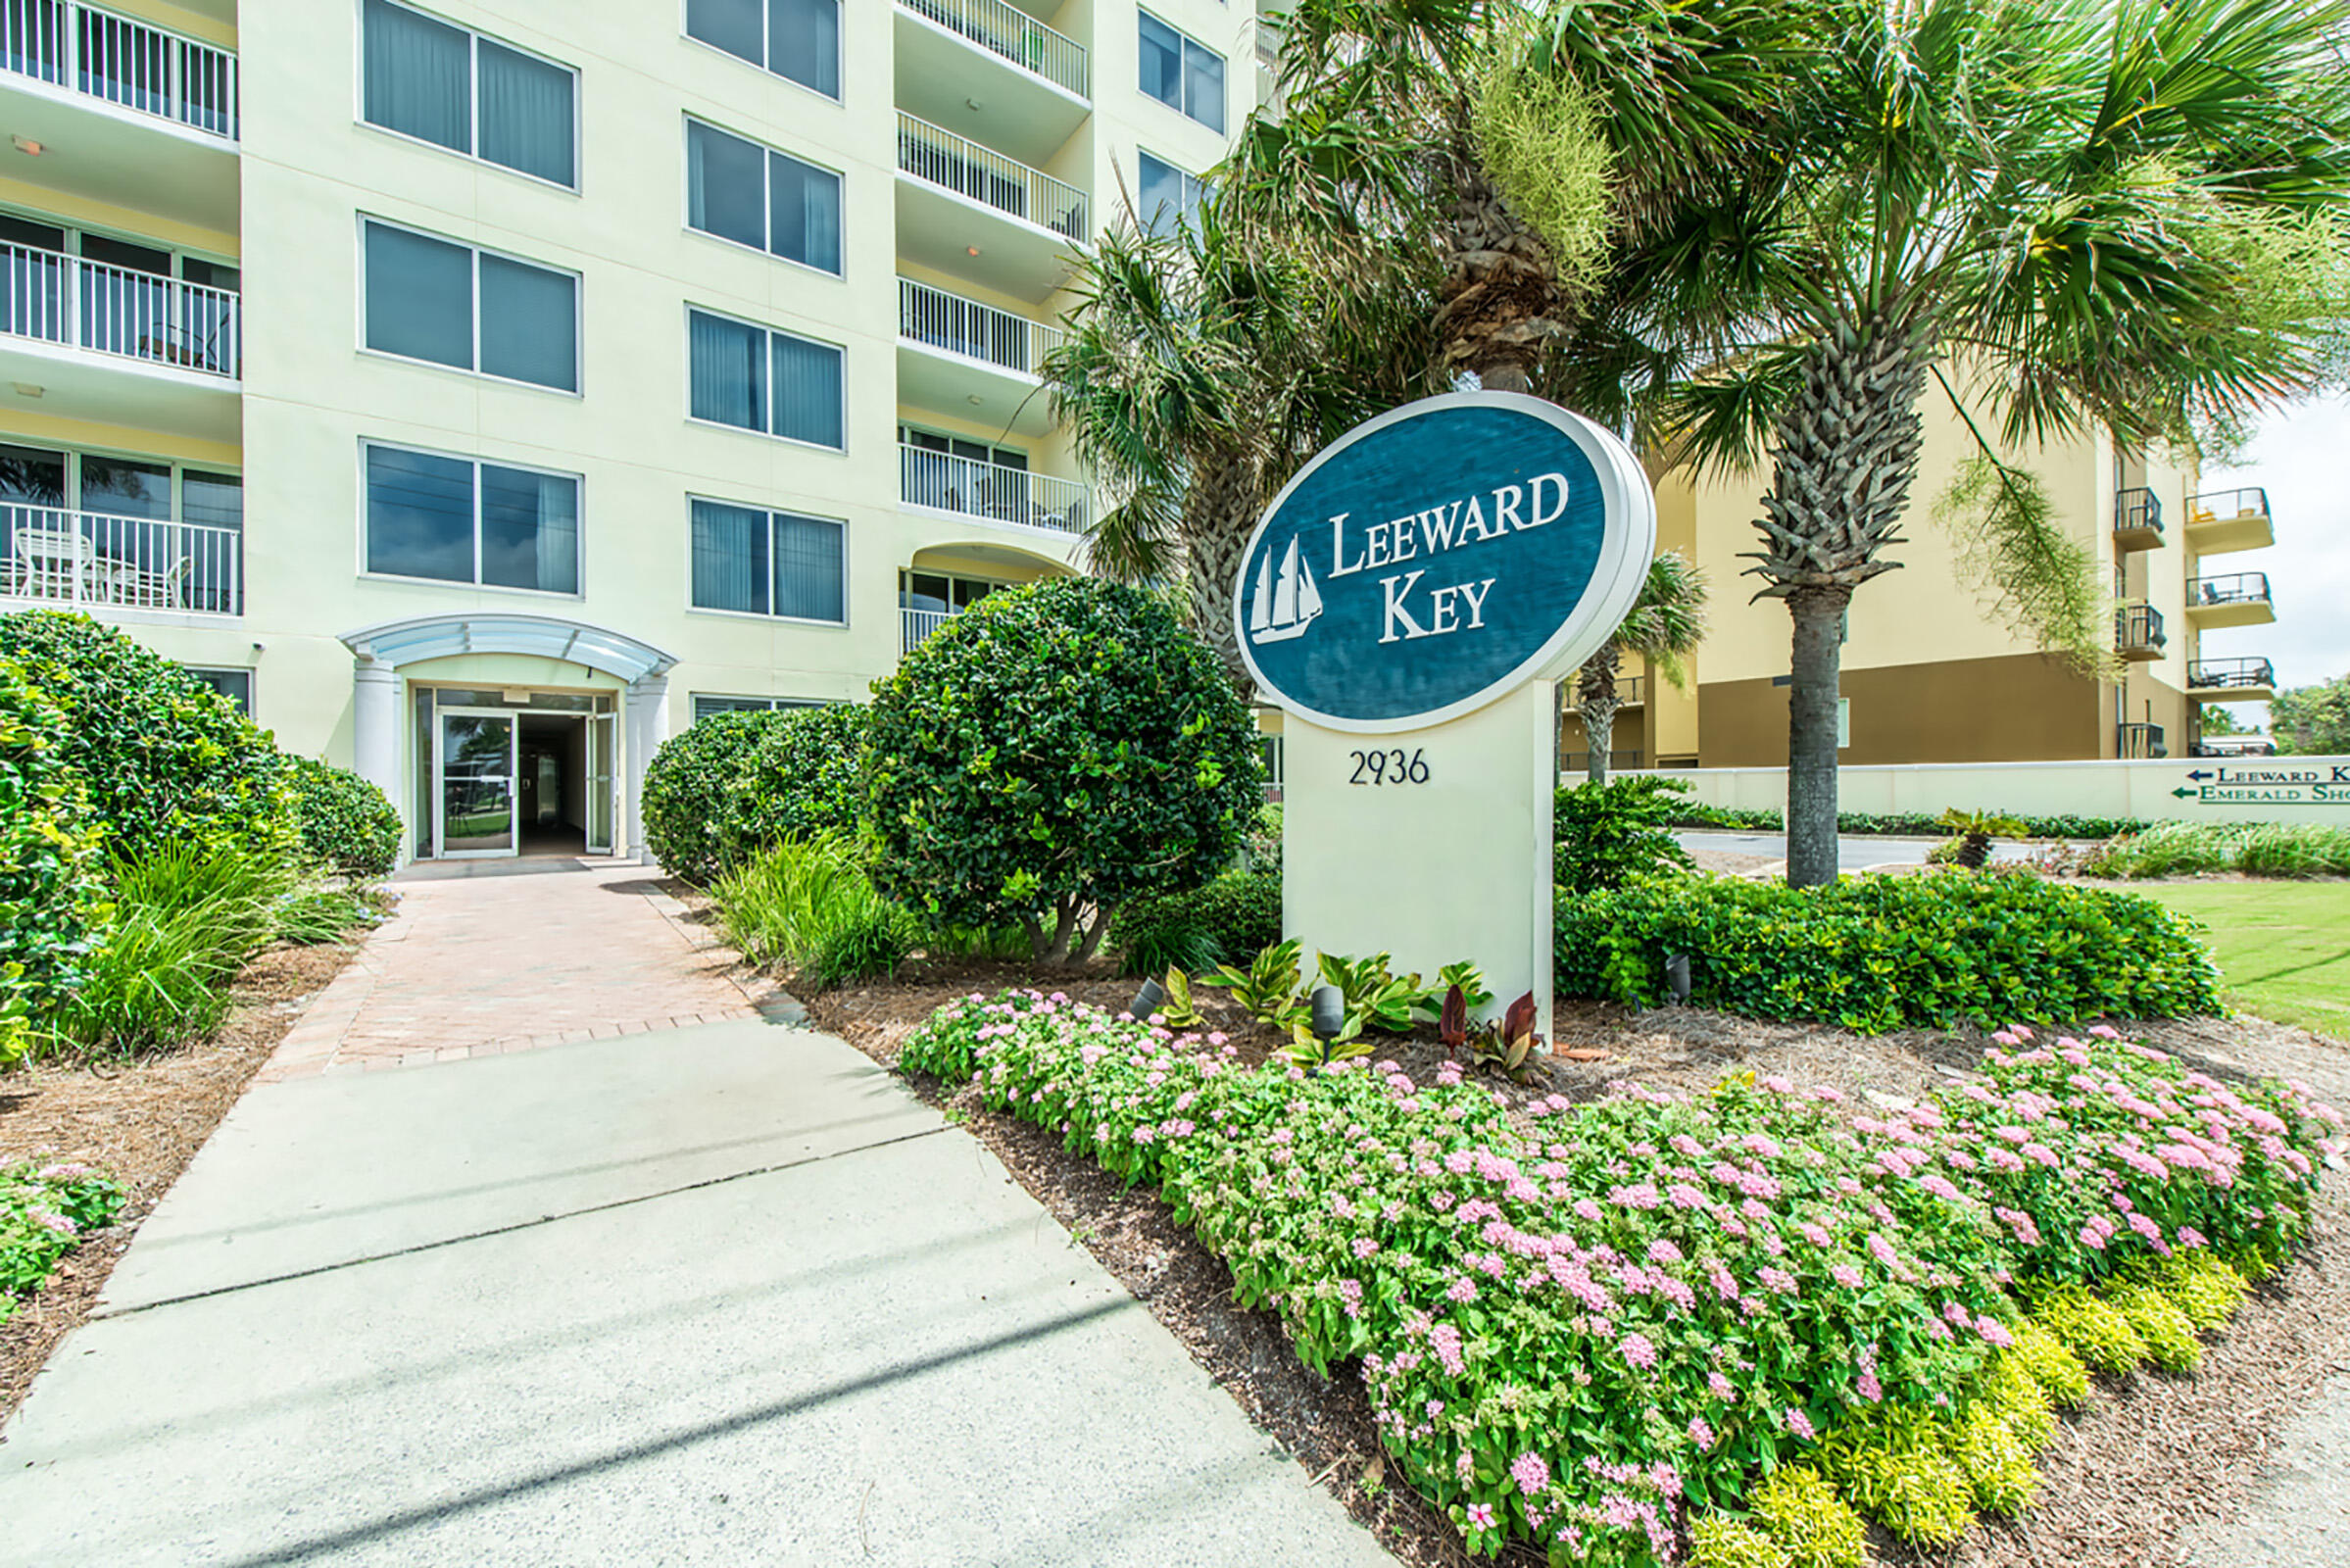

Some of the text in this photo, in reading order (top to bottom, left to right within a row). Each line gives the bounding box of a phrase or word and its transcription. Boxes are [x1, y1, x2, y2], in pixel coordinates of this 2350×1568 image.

[1328, 472, 1569, 579] LEEWARD
[1378, 569, 1496, 644] KEY
[1349, 748, 1430, 785] 2936
[2218, 767, 2319, 782] LEEWARD
[2199, 785, 2301, 801] EMERALD
